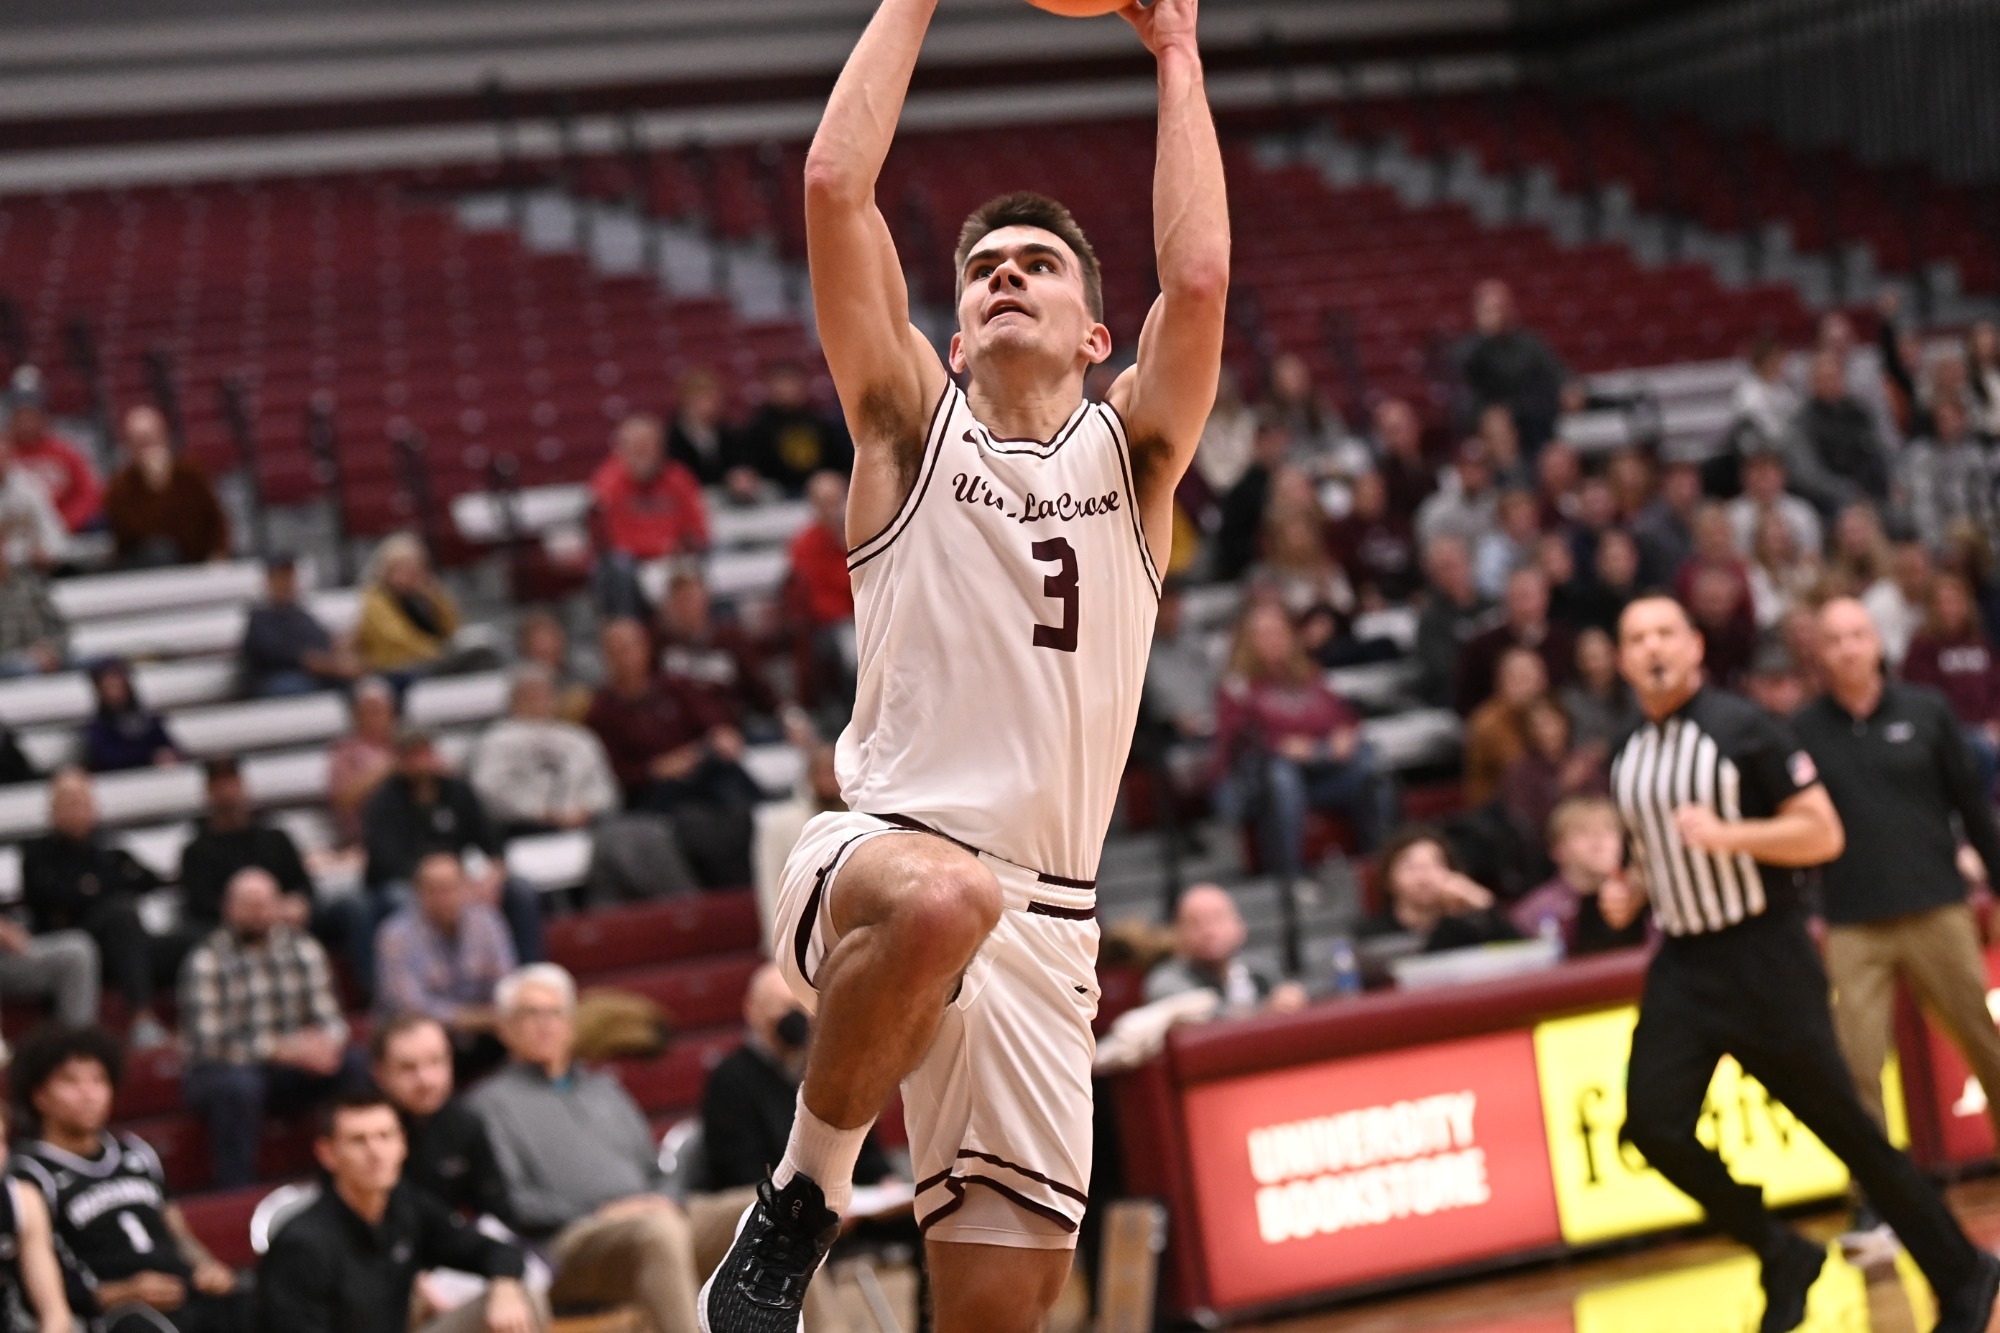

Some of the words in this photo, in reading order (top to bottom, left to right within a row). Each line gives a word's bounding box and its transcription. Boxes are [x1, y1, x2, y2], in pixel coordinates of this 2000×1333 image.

[1031, 536, 1079, 653] 3
[1247, 1089, 1477, 1186] UNIVERSITY
[1255, 1145, 1491, 1245] BOOKSTORE
